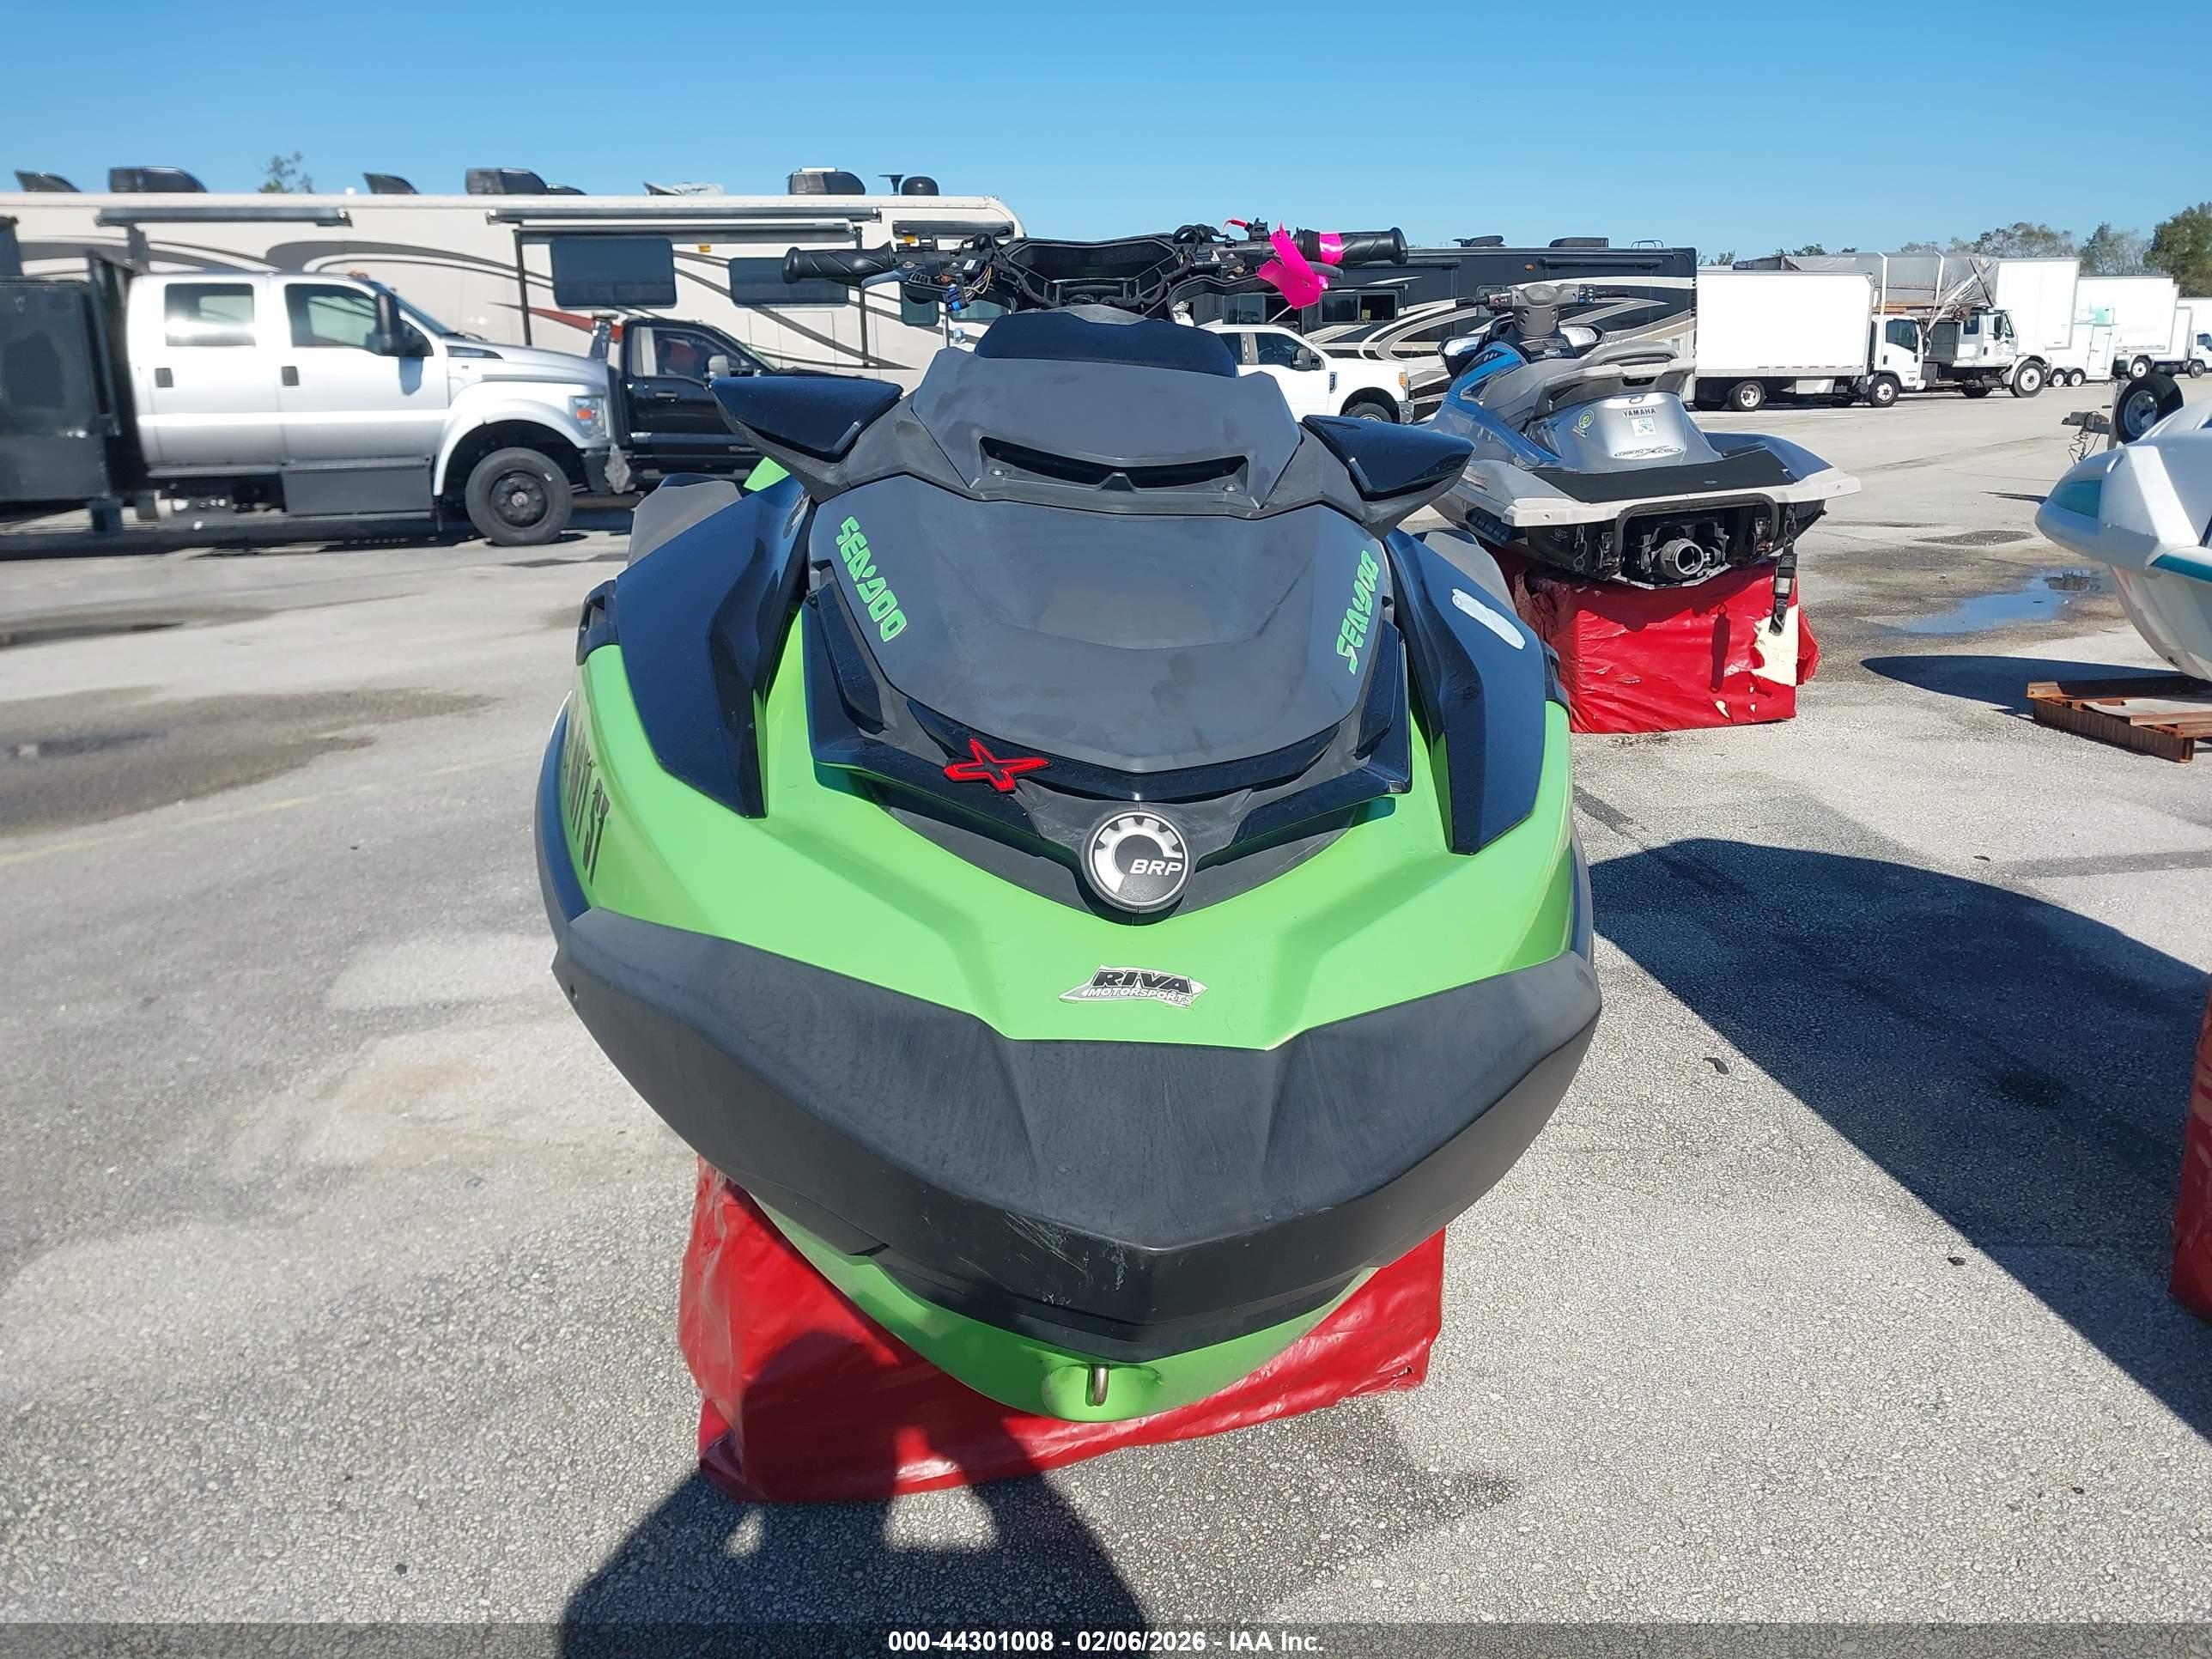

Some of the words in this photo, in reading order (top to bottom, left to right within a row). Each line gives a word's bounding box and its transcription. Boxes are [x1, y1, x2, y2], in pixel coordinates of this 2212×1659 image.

[1623, 408, 1656, 417] YAMAHA
[1129, 859, 1183, 877] BRP
[1092, 971, 1192, 994] RIVA
[1086, 988, 1194, 1005] MOTORSPORTS
